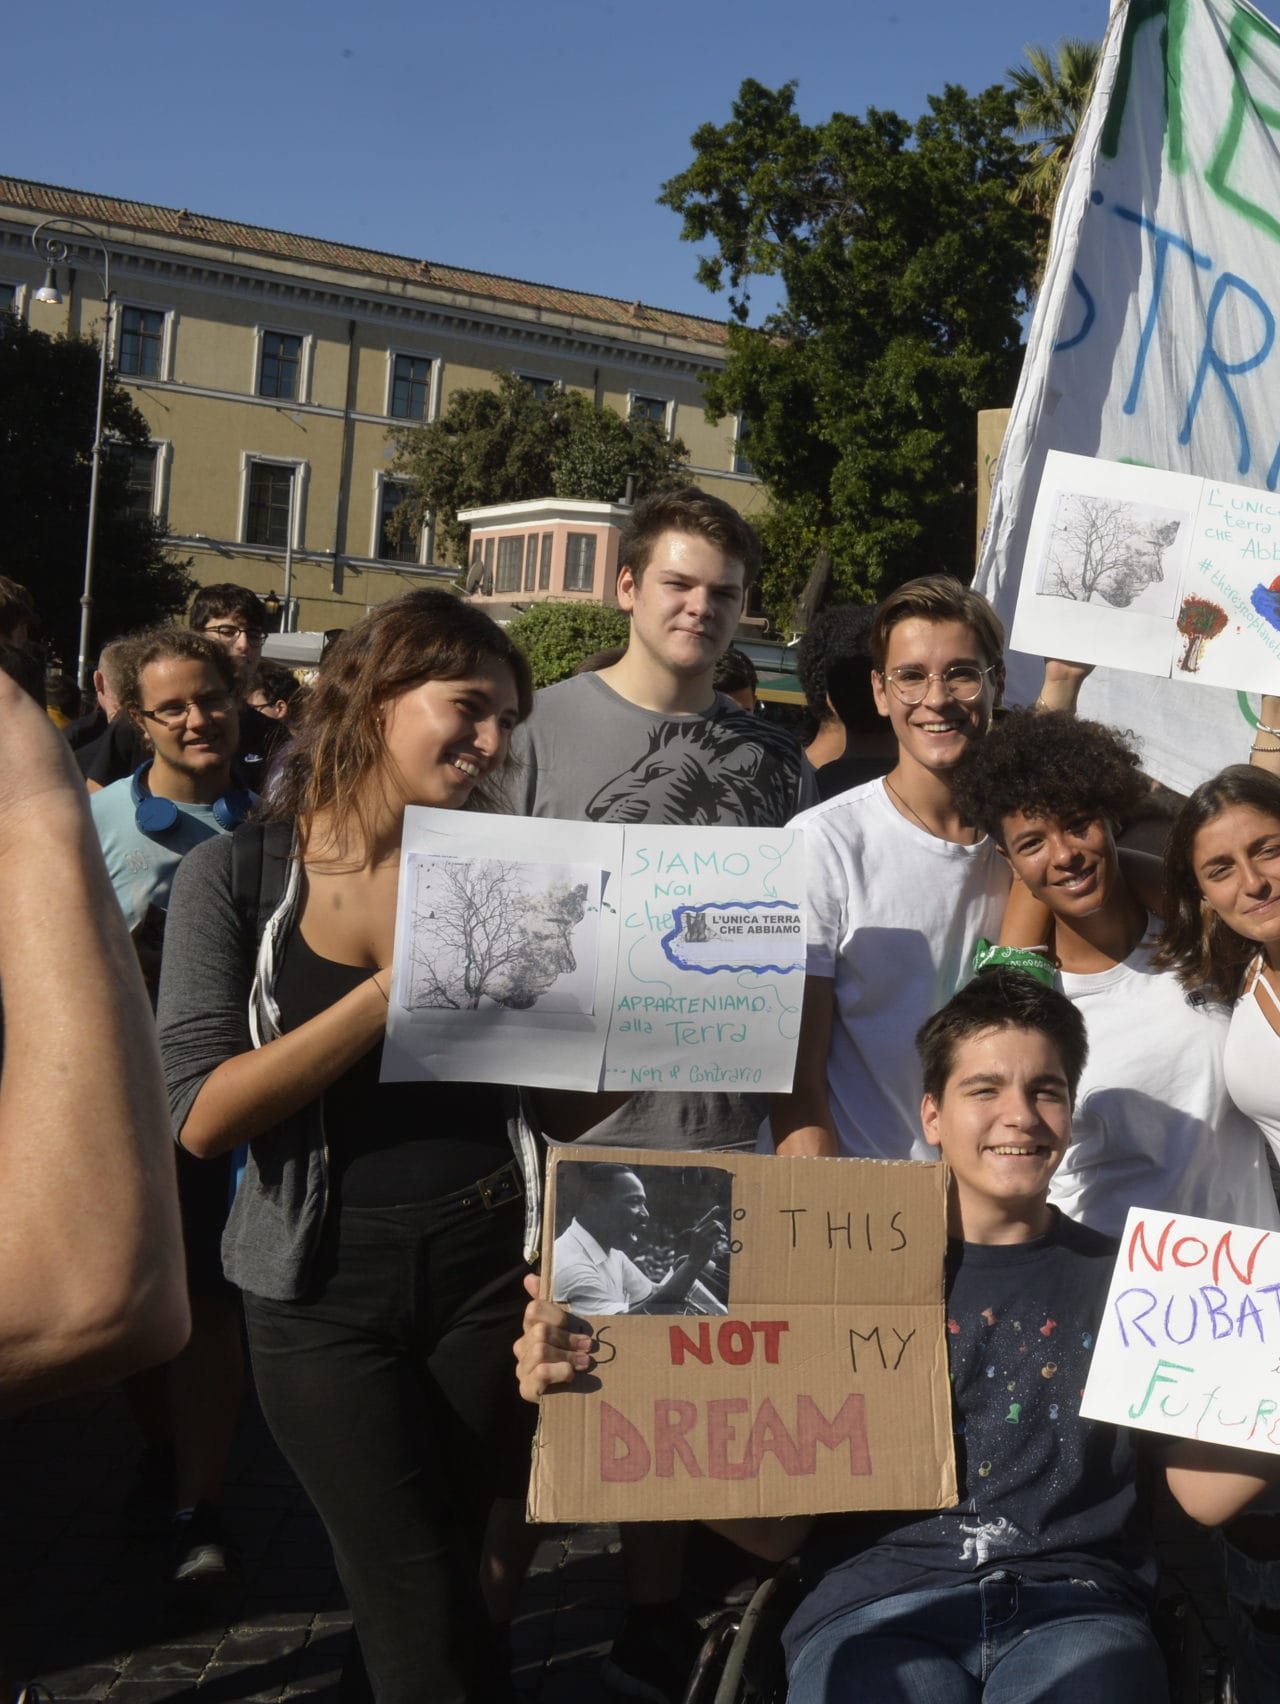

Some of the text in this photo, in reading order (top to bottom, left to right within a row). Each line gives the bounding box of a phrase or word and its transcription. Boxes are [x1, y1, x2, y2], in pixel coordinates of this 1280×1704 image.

[1204, 527, 1233, 542] CHE
[1223, 510, 1272, 534] terra
[630, 848, 751, 876] SIAMO
[654, 880, 692, 899] NOI
[624, 899, 674, 932] che
[712, 914, 801, 925] L'UNICA TERRA
[719, 925, 801, 935] CHE ABBIAMO
[617, 994, 766, 1014] APPARTENIAMO
[618, 1017, 748, 1047] alla Terra
[779, 1208, 908, 1252] THIS
[1127, 1219, 1271, 1287] NON
[668, 1320, 790, 1367] NOT
[849, 1326, 916, 1373] MY
[600, 1392, 873, 1483] DREAM
